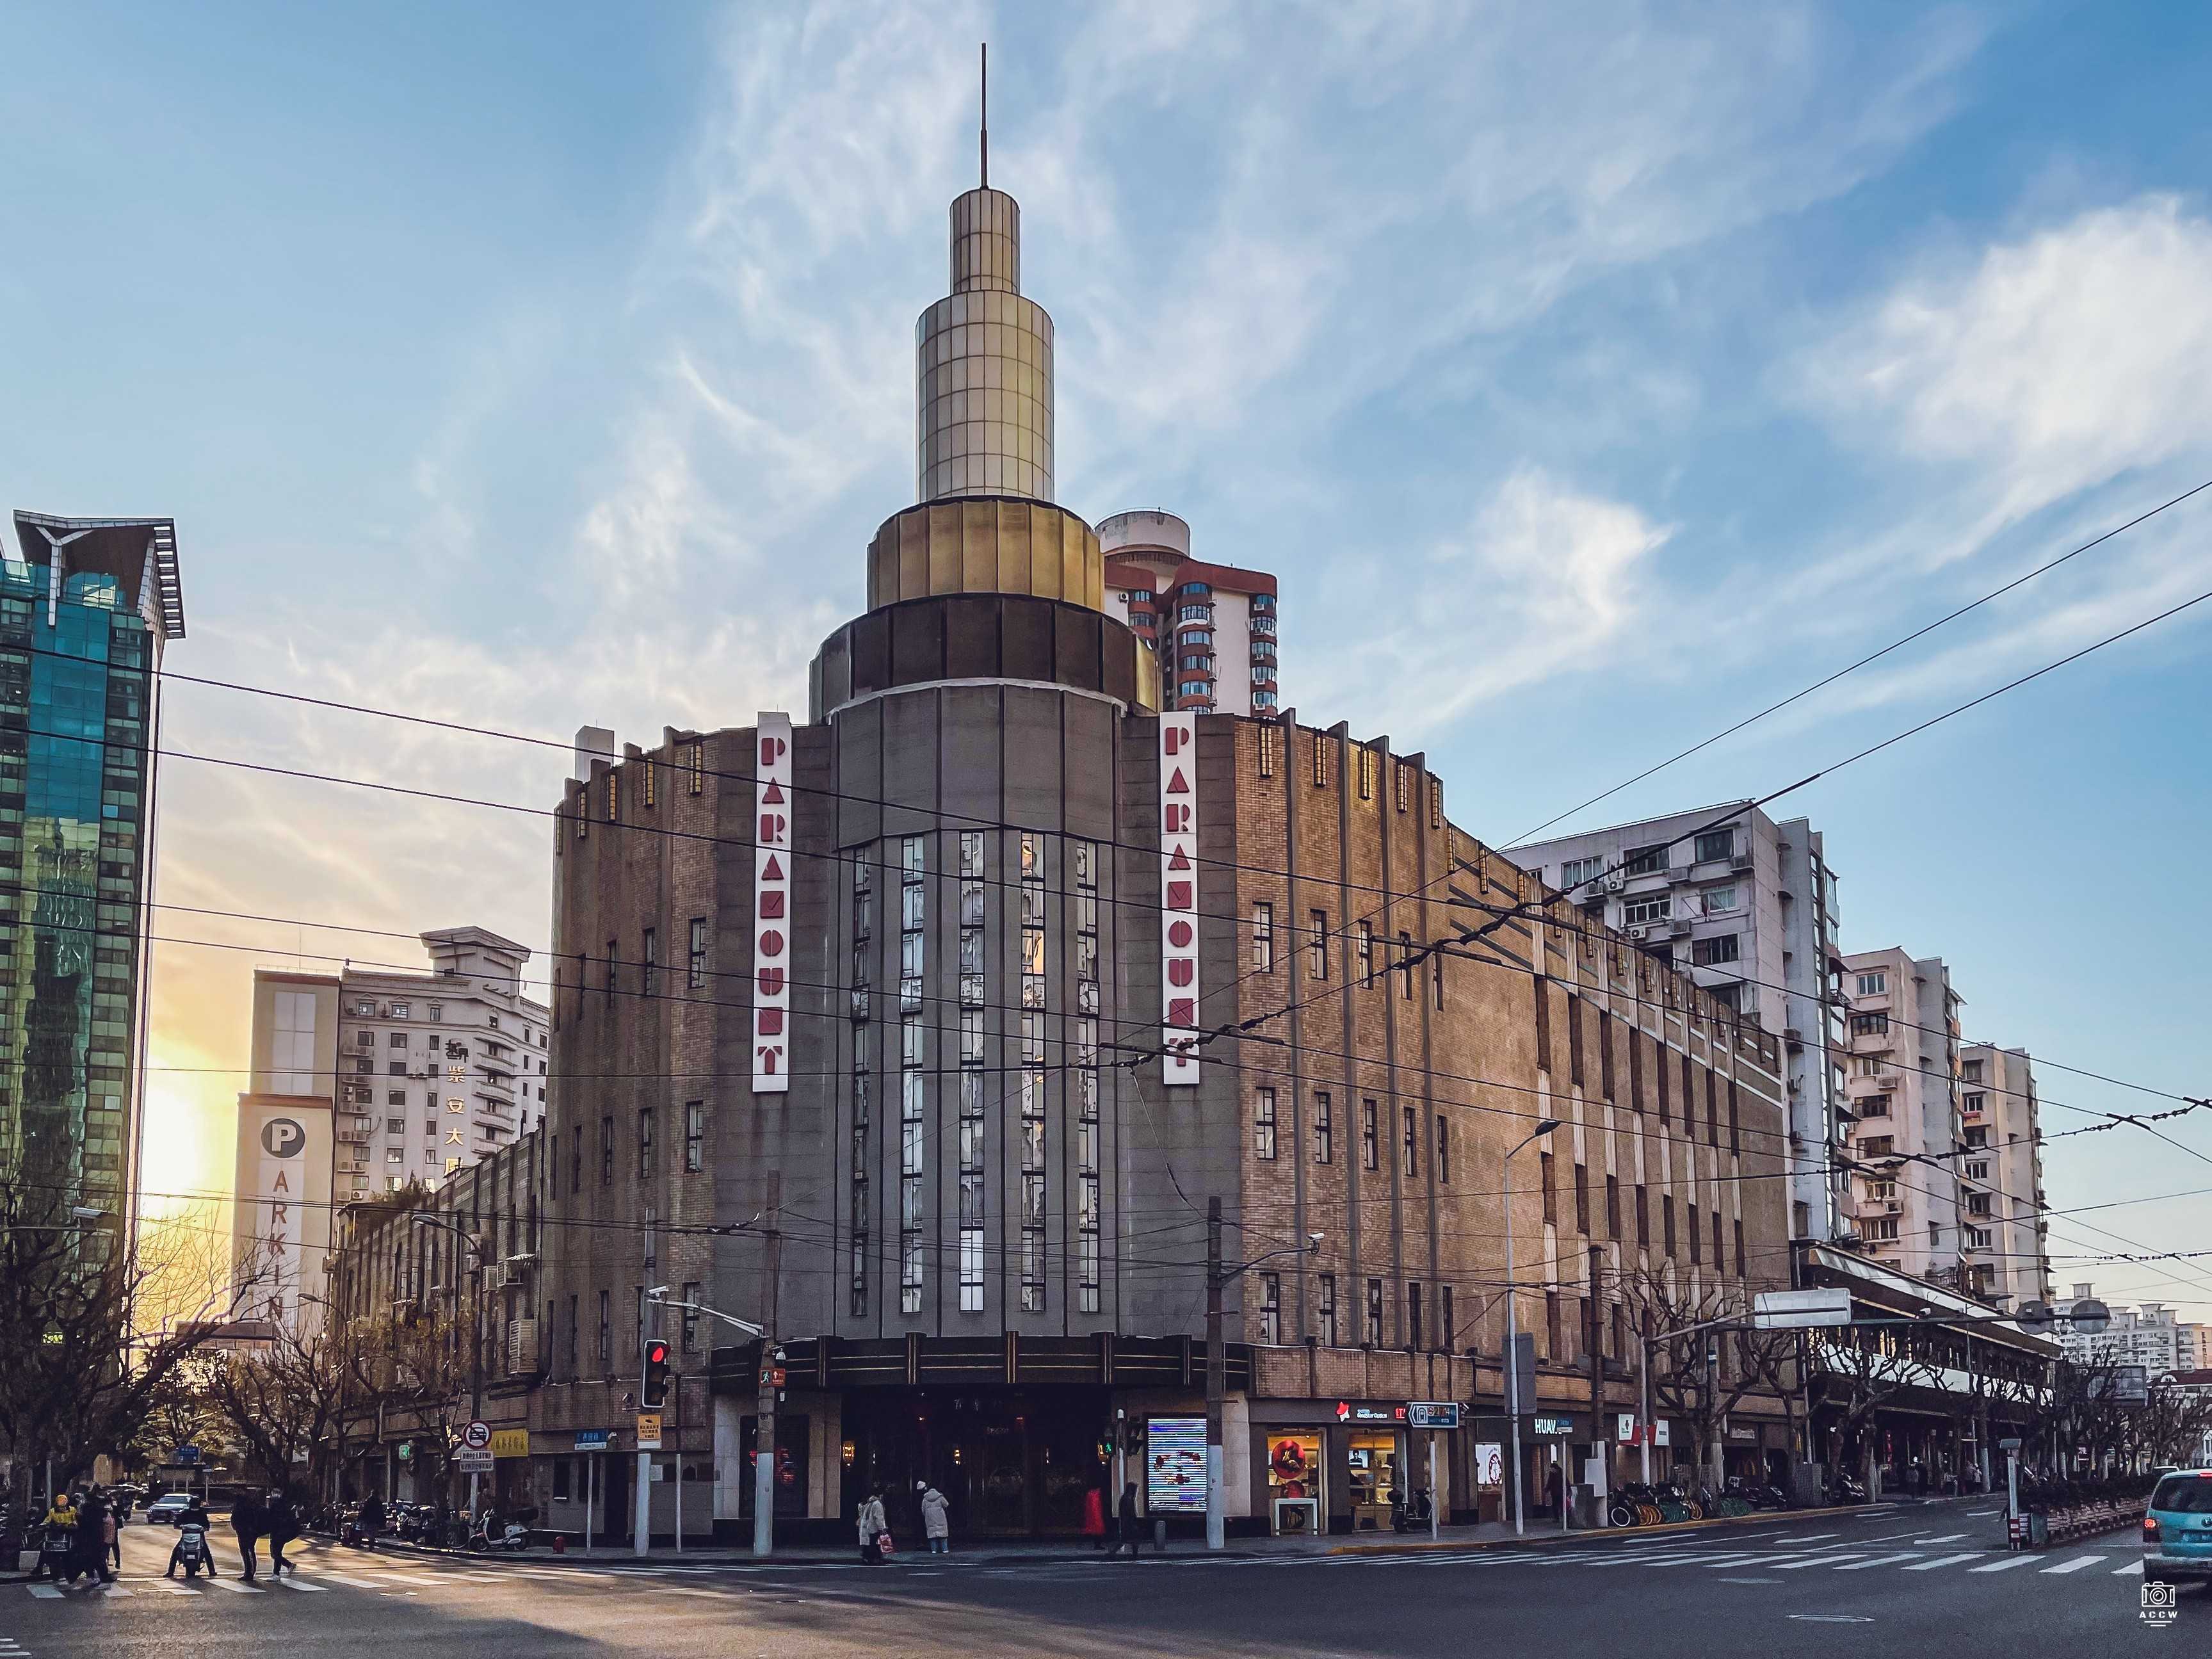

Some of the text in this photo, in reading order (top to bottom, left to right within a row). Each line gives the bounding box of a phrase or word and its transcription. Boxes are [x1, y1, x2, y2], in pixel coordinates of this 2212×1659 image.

[757, 736, 786, 1074] PARAMOUNT
[1165, 727, 1193, 1067] PARAMOUNT
[268, 1122, 297, 1348] PARKIN
